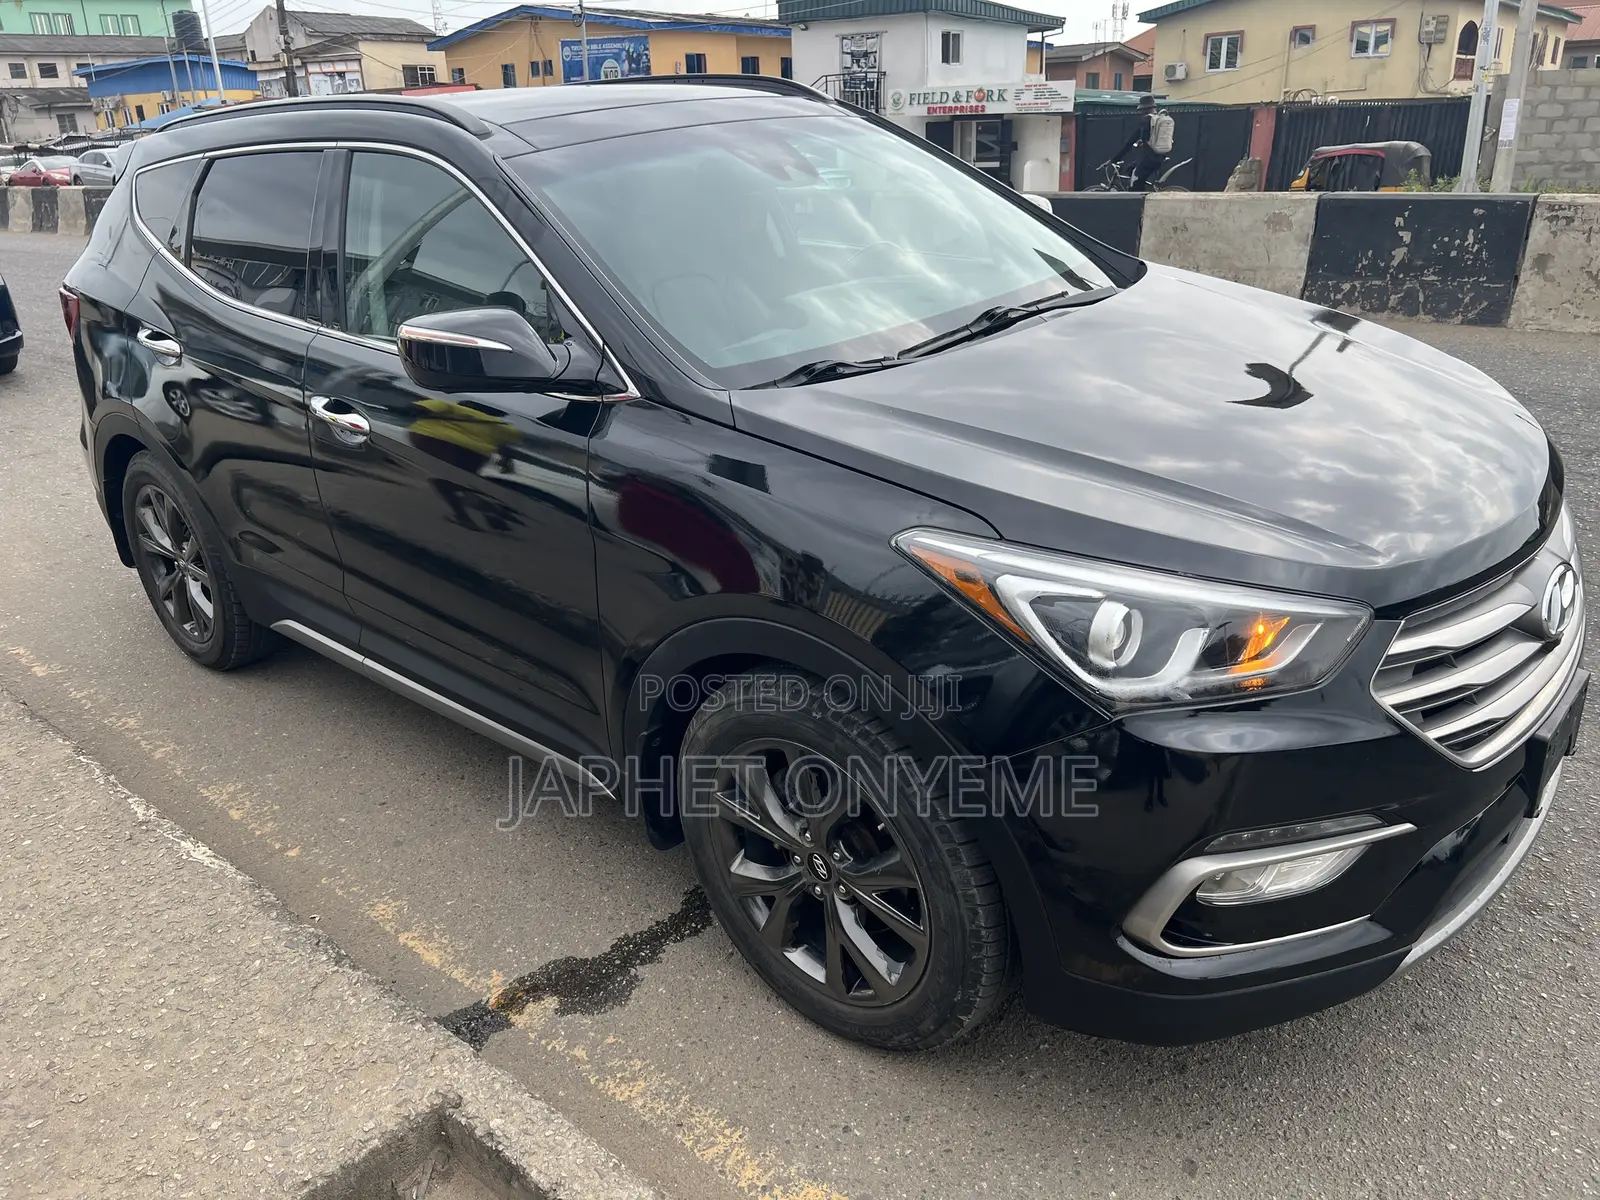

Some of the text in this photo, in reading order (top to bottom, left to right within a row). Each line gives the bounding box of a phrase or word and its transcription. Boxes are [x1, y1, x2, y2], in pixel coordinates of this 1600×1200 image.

[908, 91, 950, 106] FIELD
[952, 90, 963, 103] &
[927, 104, 986, 115] ENTERPRISES
